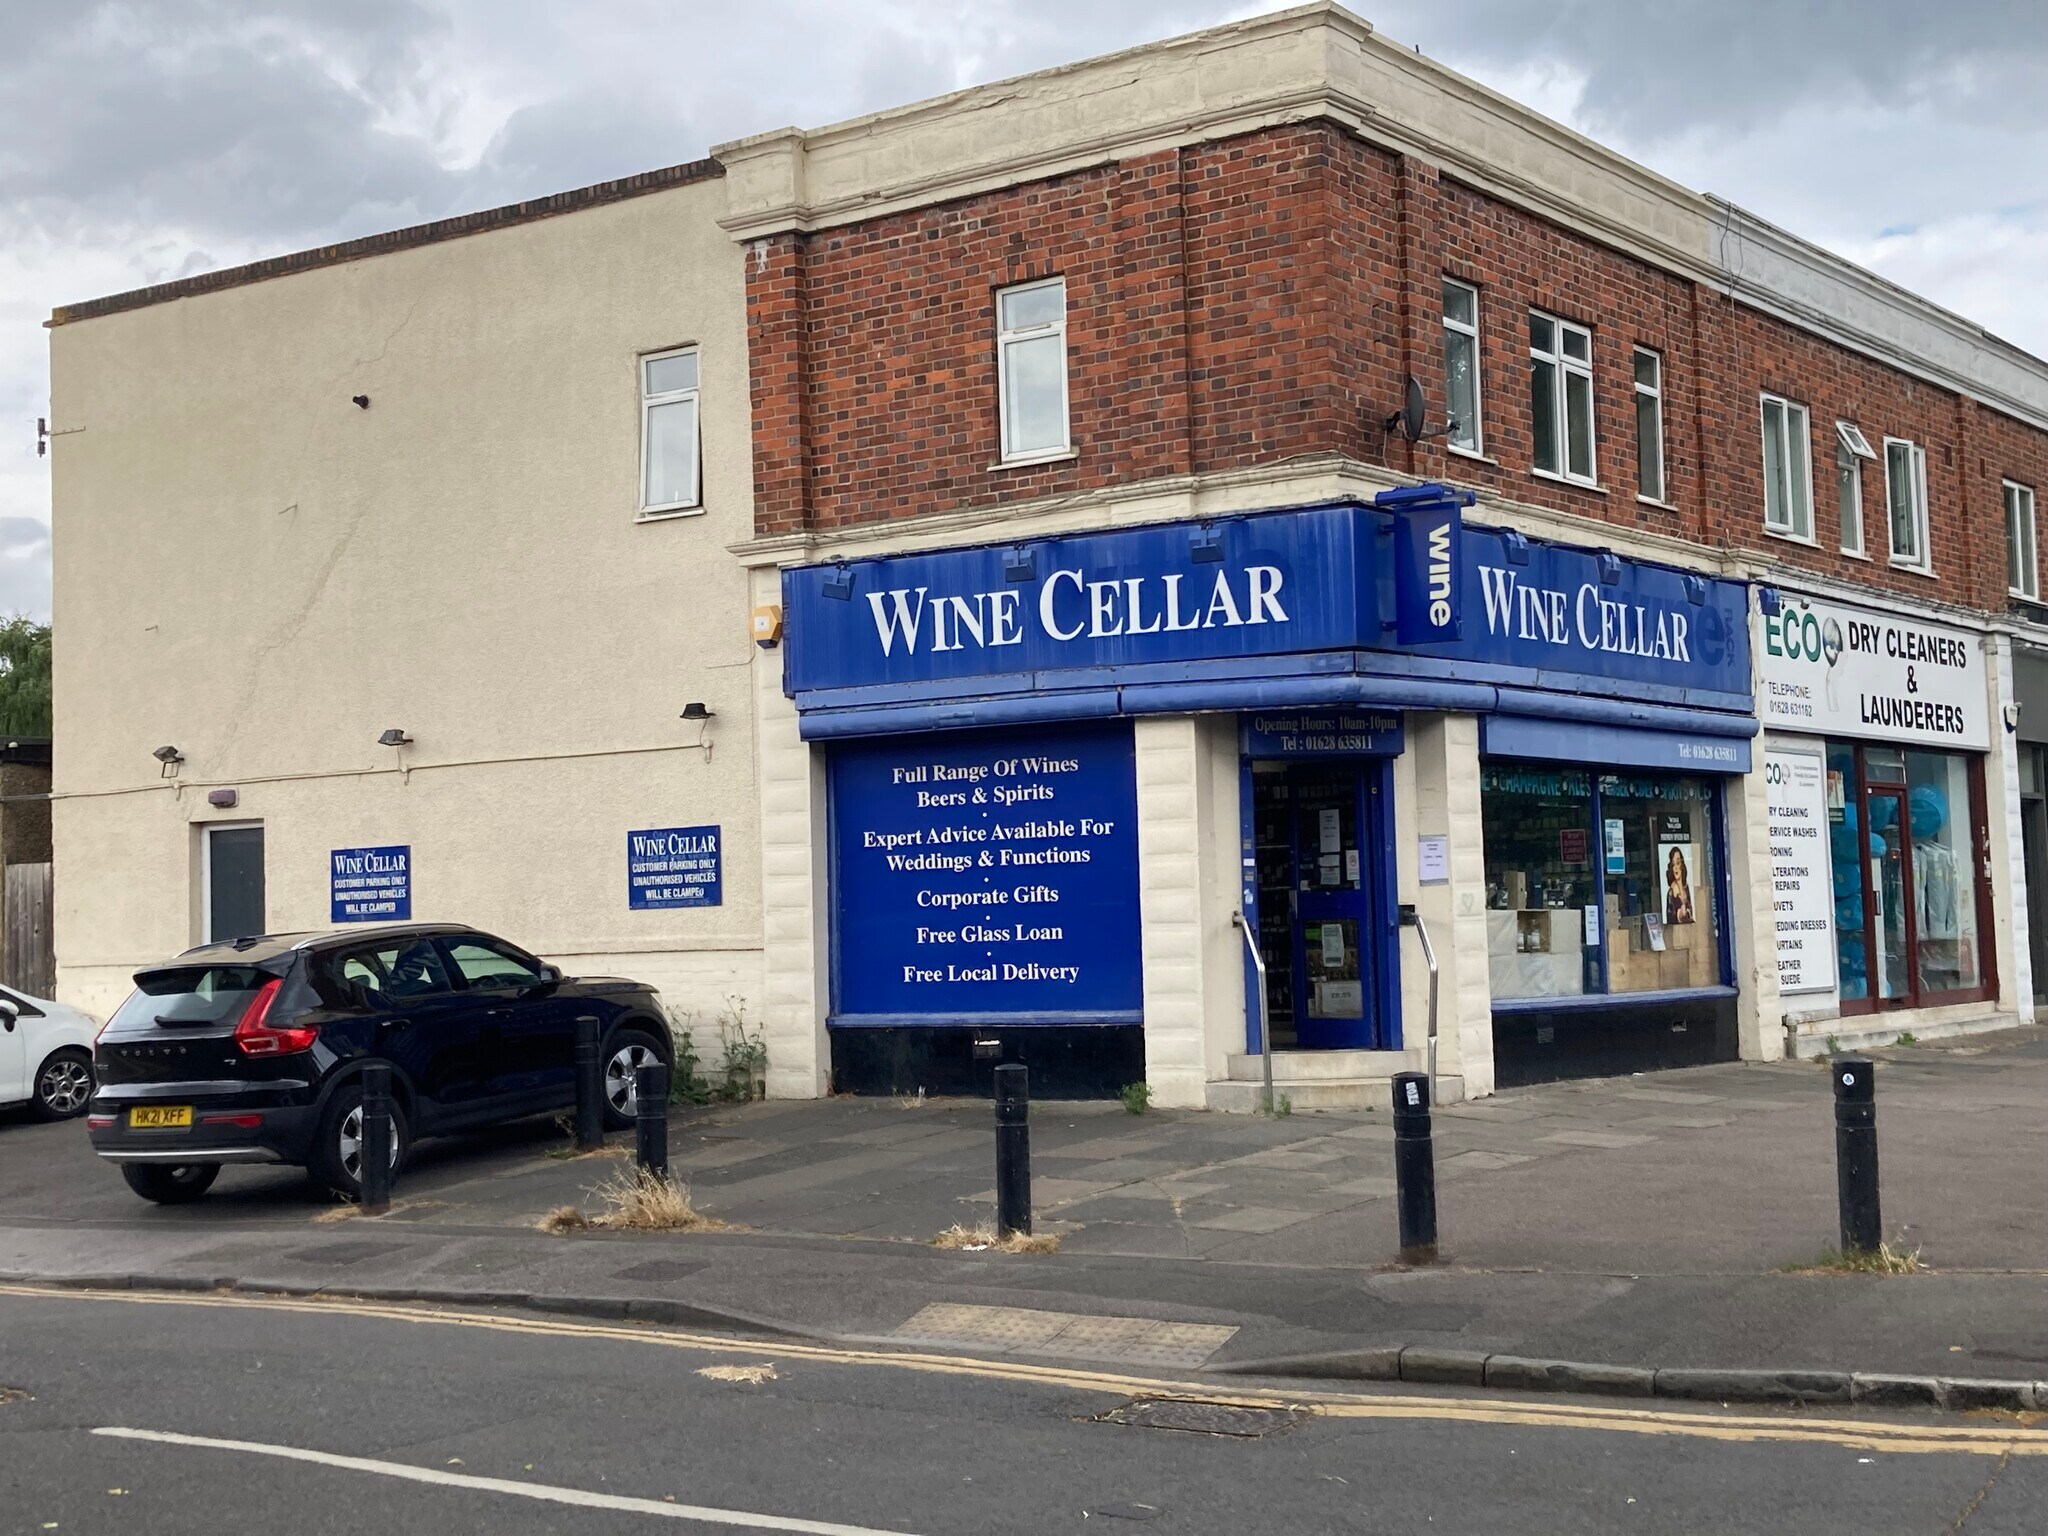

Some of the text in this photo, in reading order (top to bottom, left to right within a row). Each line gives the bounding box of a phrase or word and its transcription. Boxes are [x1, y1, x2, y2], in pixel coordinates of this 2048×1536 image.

[1429, 523, 1450, 627] wine
[866, 566, 1289, 657] WINE CELLAR
[1478, 565, 1691, 663] WINE CELLAR
[1766, 609, 1821, 662] ECO
[1848, 621, 1966, 668] DRY CLEANERS
[1907, 665, 1918, 693] &
[1769, 682, 1811, 699] TELEPHONE:
[1770, 700, 1789, 714] 01628
[1861, 693, 1964, 734] LAUNDERERS
[1255, 715, 1397, 734] Opening Hours: 10am-10pm
[1306, 736, 1335, 750] 01628
[1338, 735, 1372, 750] 635811
[1693, 745, 1713, 759] 01628
[893, 757, 1079, 784] Full Range Of Wines
[1766, 763, 1781, 784] CO
[917, 784, 1054, 807] Beers & Spirits
[1768, 807, 1808, 818] RY CLEANING
[863, 819, 1114, 850] Expert Advice Available For
[1769, 827, 1817, 838] ERVICE WASHES
[633, 834, 716, 857] WINE CELLAR
[1770, 847, 1792, 857] RONING
[335, 853, 406, 875] WINE CELLAR
[632, 862, 668, 873] CUSTOMER
[699, 859, 716, 869] ONLY
[886, 846, 1091, 872] Weddings & Functions
[633, 872, 716, 886] UNAUTHORISED VEHICLES
[1772, 867, 1808, 877] LTERATIONS
[335, 878, 365, 888] CUSTOMER
[391, 876, 406, 886] ONLY
[1775, 881, 1800, 890] REPAIRS
[379, 889, 406, 899] VEHICLES
[645, 889, 662, 899] WILL
[663, 888, 672, 898] BE
[917, 886, 1059, 910] Corporate Gifts
[346, 902, 396, 913] WILL BE CLAMPED
[1773, 901, 1793, 911] UVETS
[1775, 920, 1827, 931] EDDING DRESSES
[916, 924, 1063, 944] Free Glass Loan
[1777, 940, 1802, 950] URTAINS
[1777, 960, 1801, 970] EATHER
[903, 963, 1080, 983] Free Local Delivery
[1781, 974, 1801, 985] SUEDE
[137, 1109, 185, 1124] HK21 XFF
